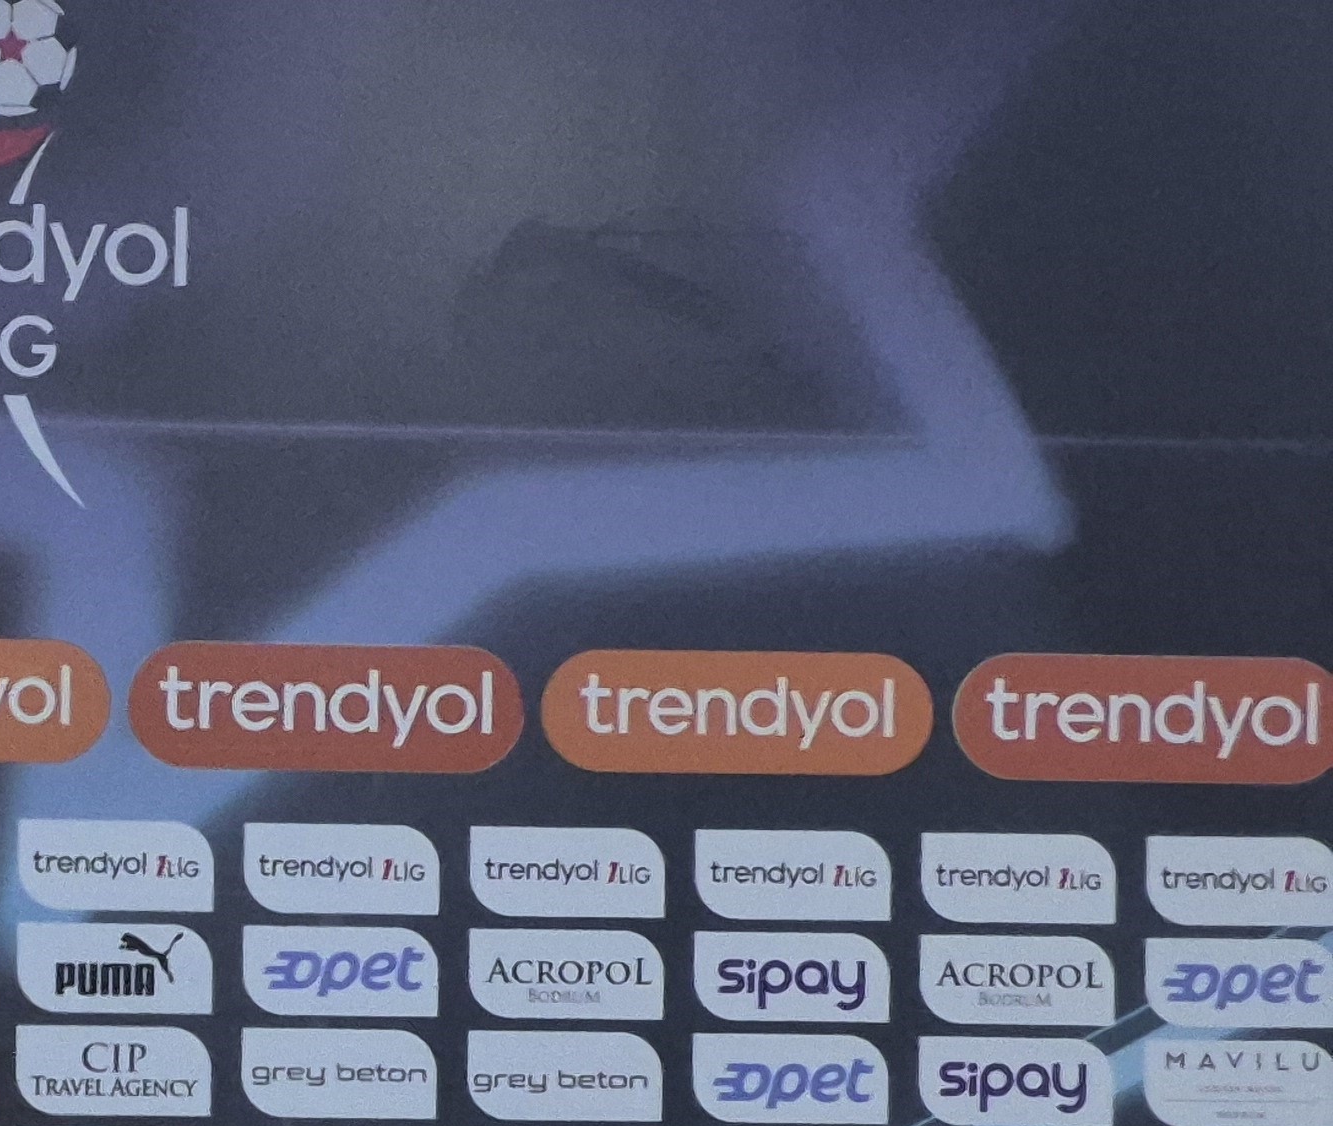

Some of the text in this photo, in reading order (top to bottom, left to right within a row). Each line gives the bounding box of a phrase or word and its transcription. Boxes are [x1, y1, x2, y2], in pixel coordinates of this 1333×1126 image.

[159, 666, 493, 748] trendyol
[579, 674, 894, 750] trendyol
[985, 678, 1319, 759] trendyol
[33, 851, 147, 879] trendyol
[259, 855, 372, 882] trendyol
[485, 859, 599, 885] trendyol
[710, 862, 824, 888] trendyol
[936, 865, 1050, 891] trendyol
[1161, 868, 1275, 894] trendyol
[55, 962, 155, 996] PUMA
[264, 945, 425, 997] opet
[487, 958, 651, 985] ACROPOL
[718, 959, 866, 1011] sipay
[937, 961, 1102, 989] ACROPOL
[1162, 959, 1324, 1010] opet
[82, 1042, 146, 1073] CIP
[31, 1075, 197, 1097] TRAVEL AGENCY
[252, 1063, 427, 1087] grey beton
[473, 1070, 648, 1093] grey beton
[713, 1059, 874, 1109] opet
[939, 1062, 1087, 1114] sipay
